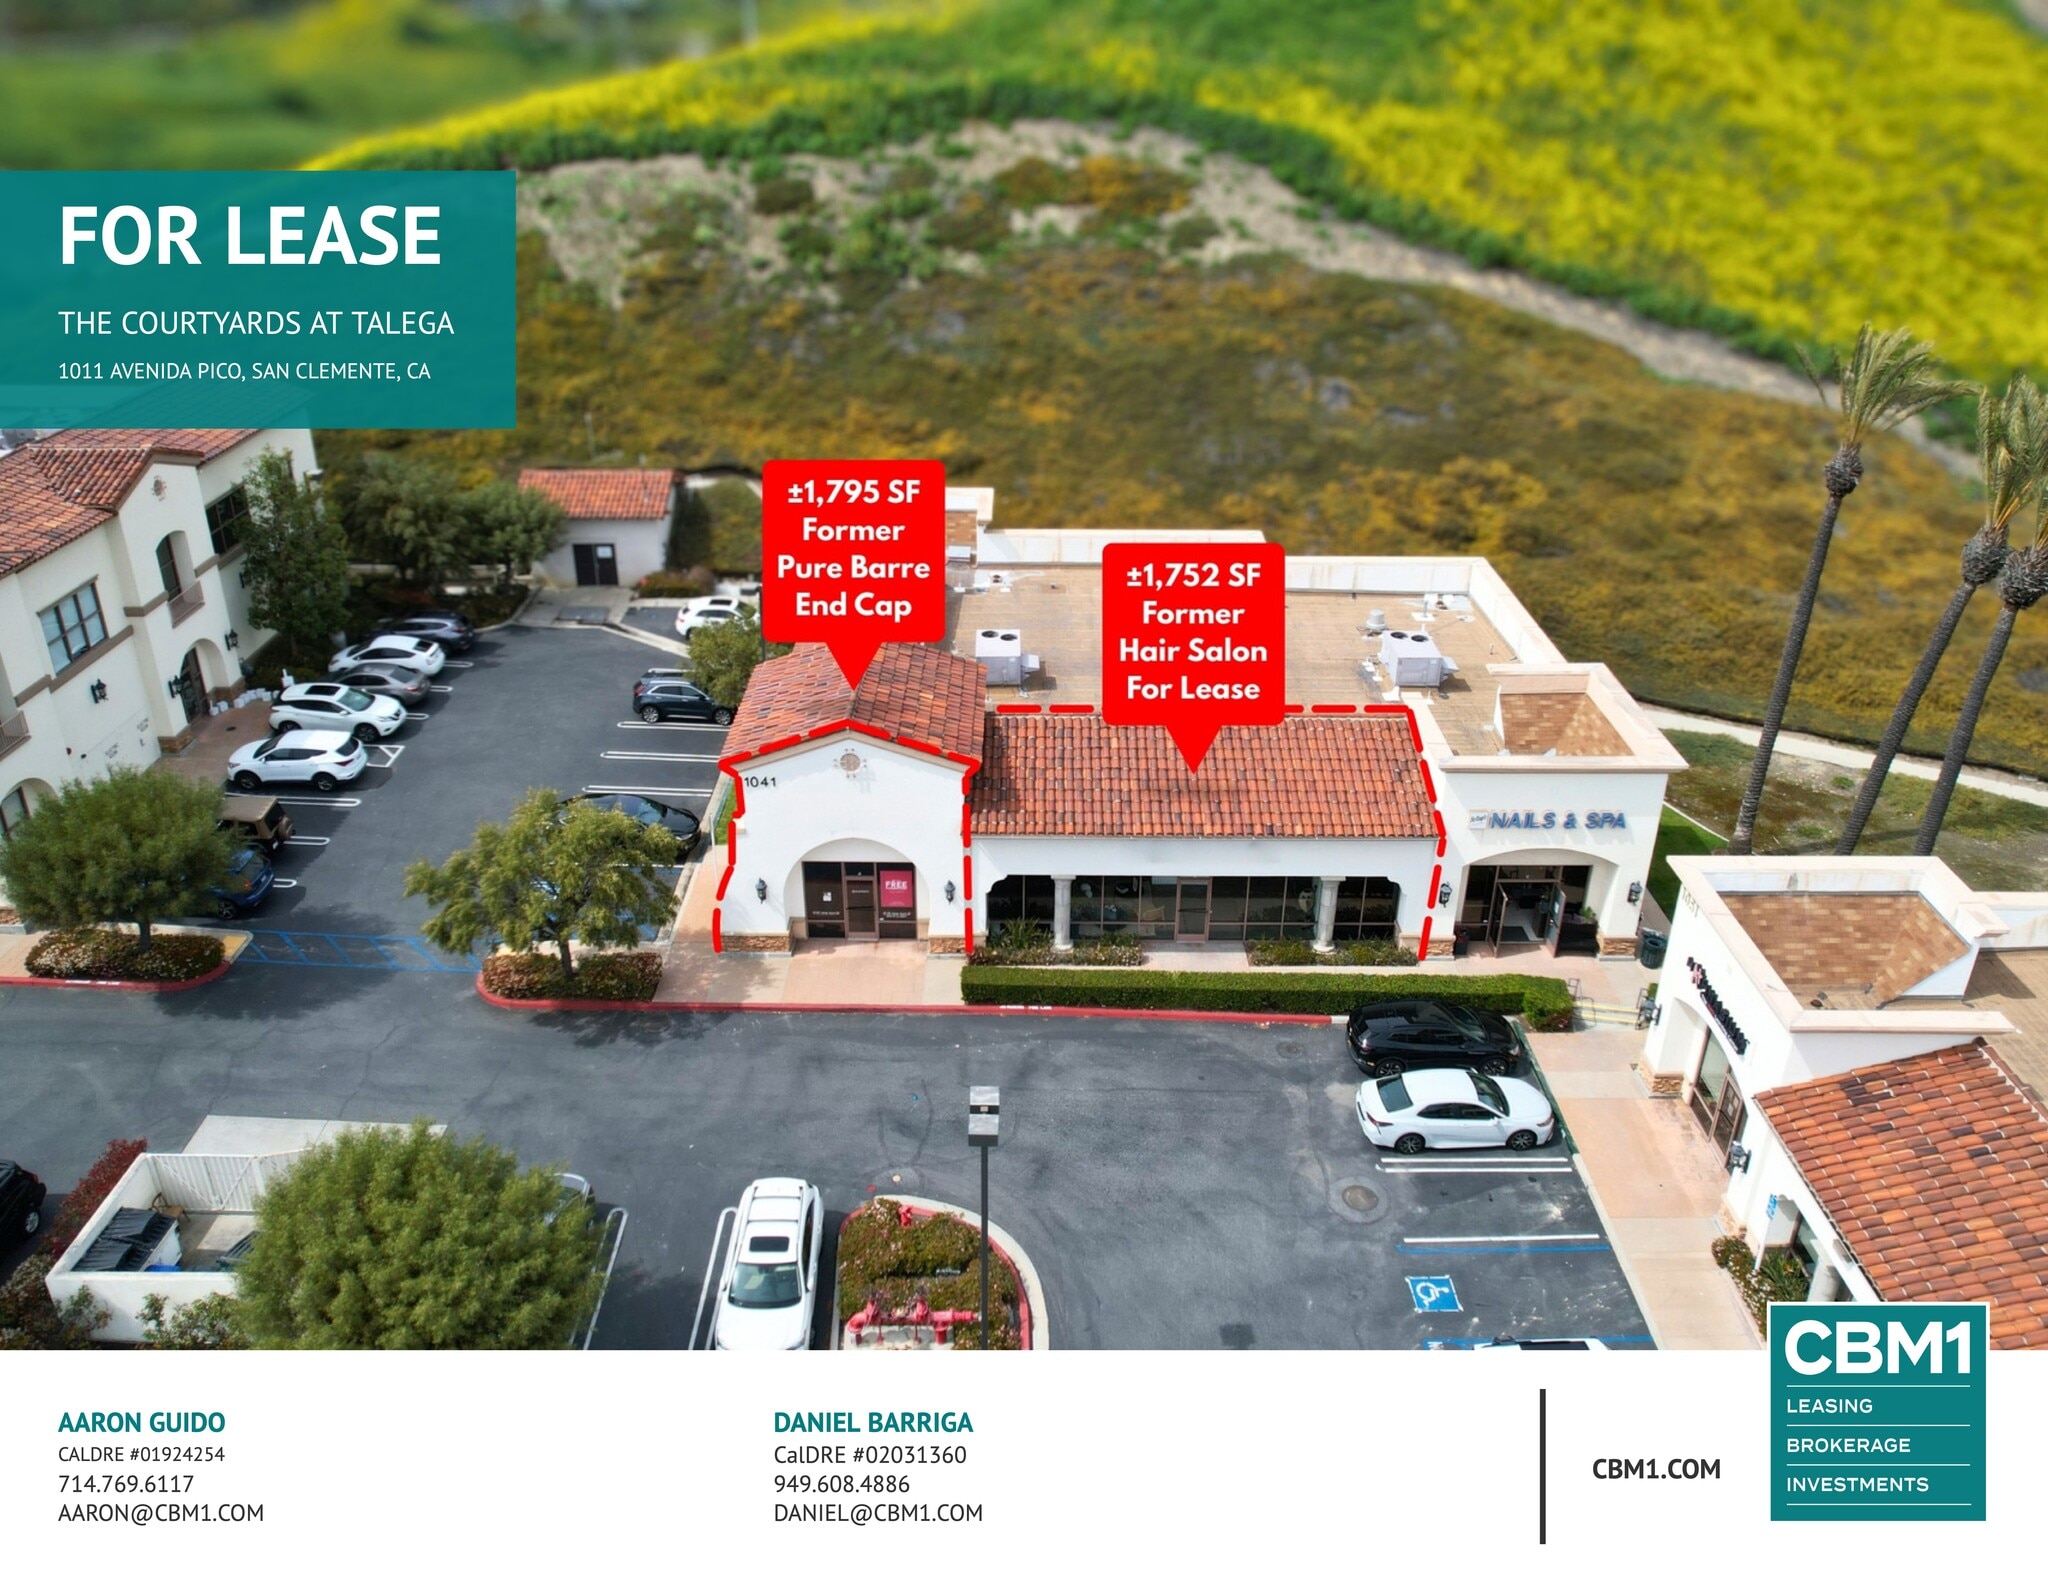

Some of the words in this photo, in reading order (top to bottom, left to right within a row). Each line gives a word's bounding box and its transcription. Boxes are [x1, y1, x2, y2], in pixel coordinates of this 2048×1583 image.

[744, 777, 777, 788] 1041
[1490, 812, 1556, 829] NAILS
[1563, 813, 1576, 829] &
[1586, 812, 1626, 829] SPA
[885, 881, 908, 890] FREE
